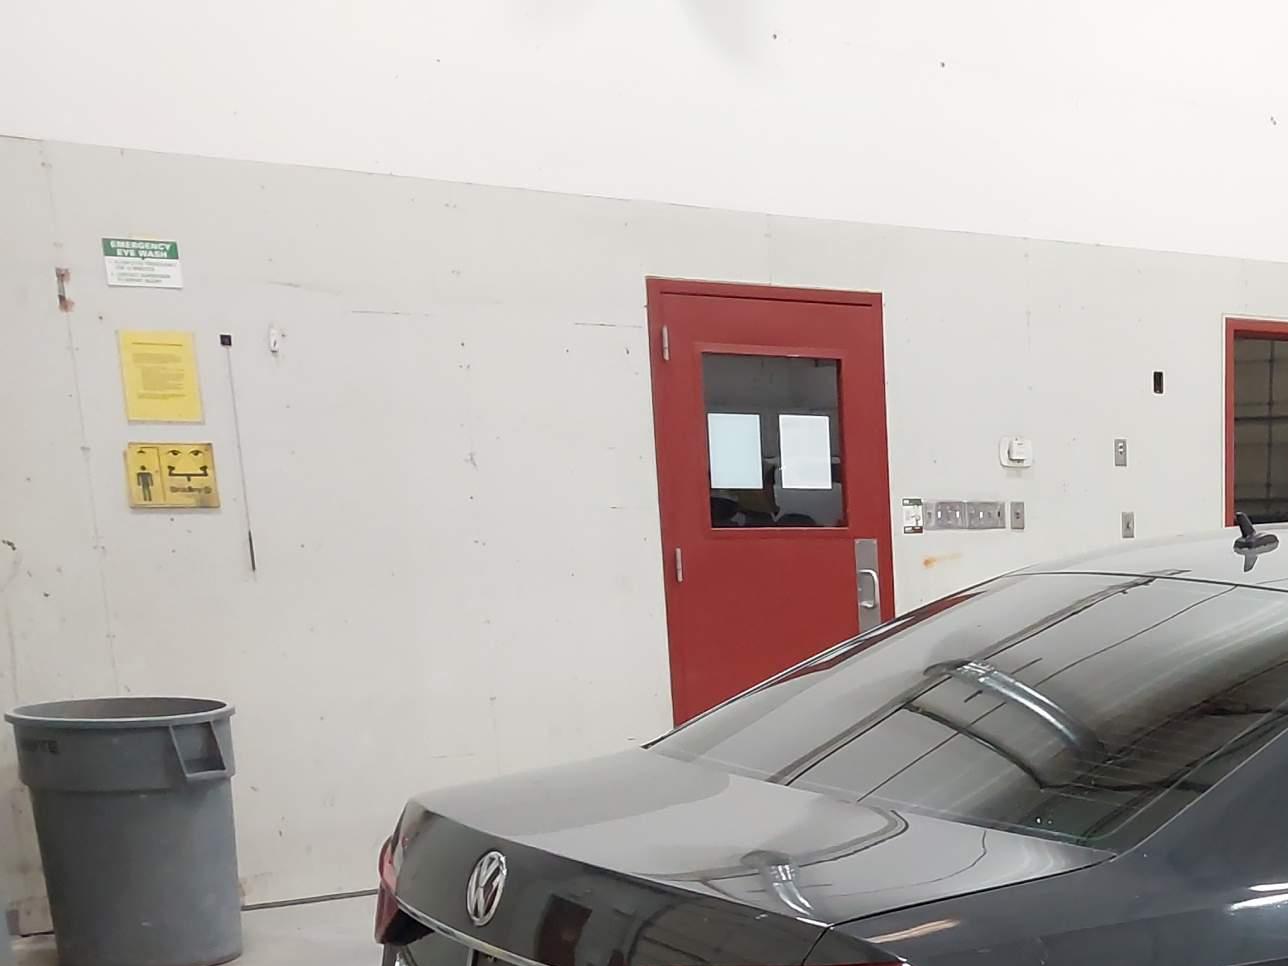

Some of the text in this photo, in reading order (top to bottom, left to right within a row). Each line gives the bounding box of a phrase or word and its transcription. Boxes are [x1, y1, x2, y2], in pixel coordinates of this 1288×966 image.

[110, 240, 172, 251] EMERGENCY
[116, 248, 168, 258] EYE WASH
